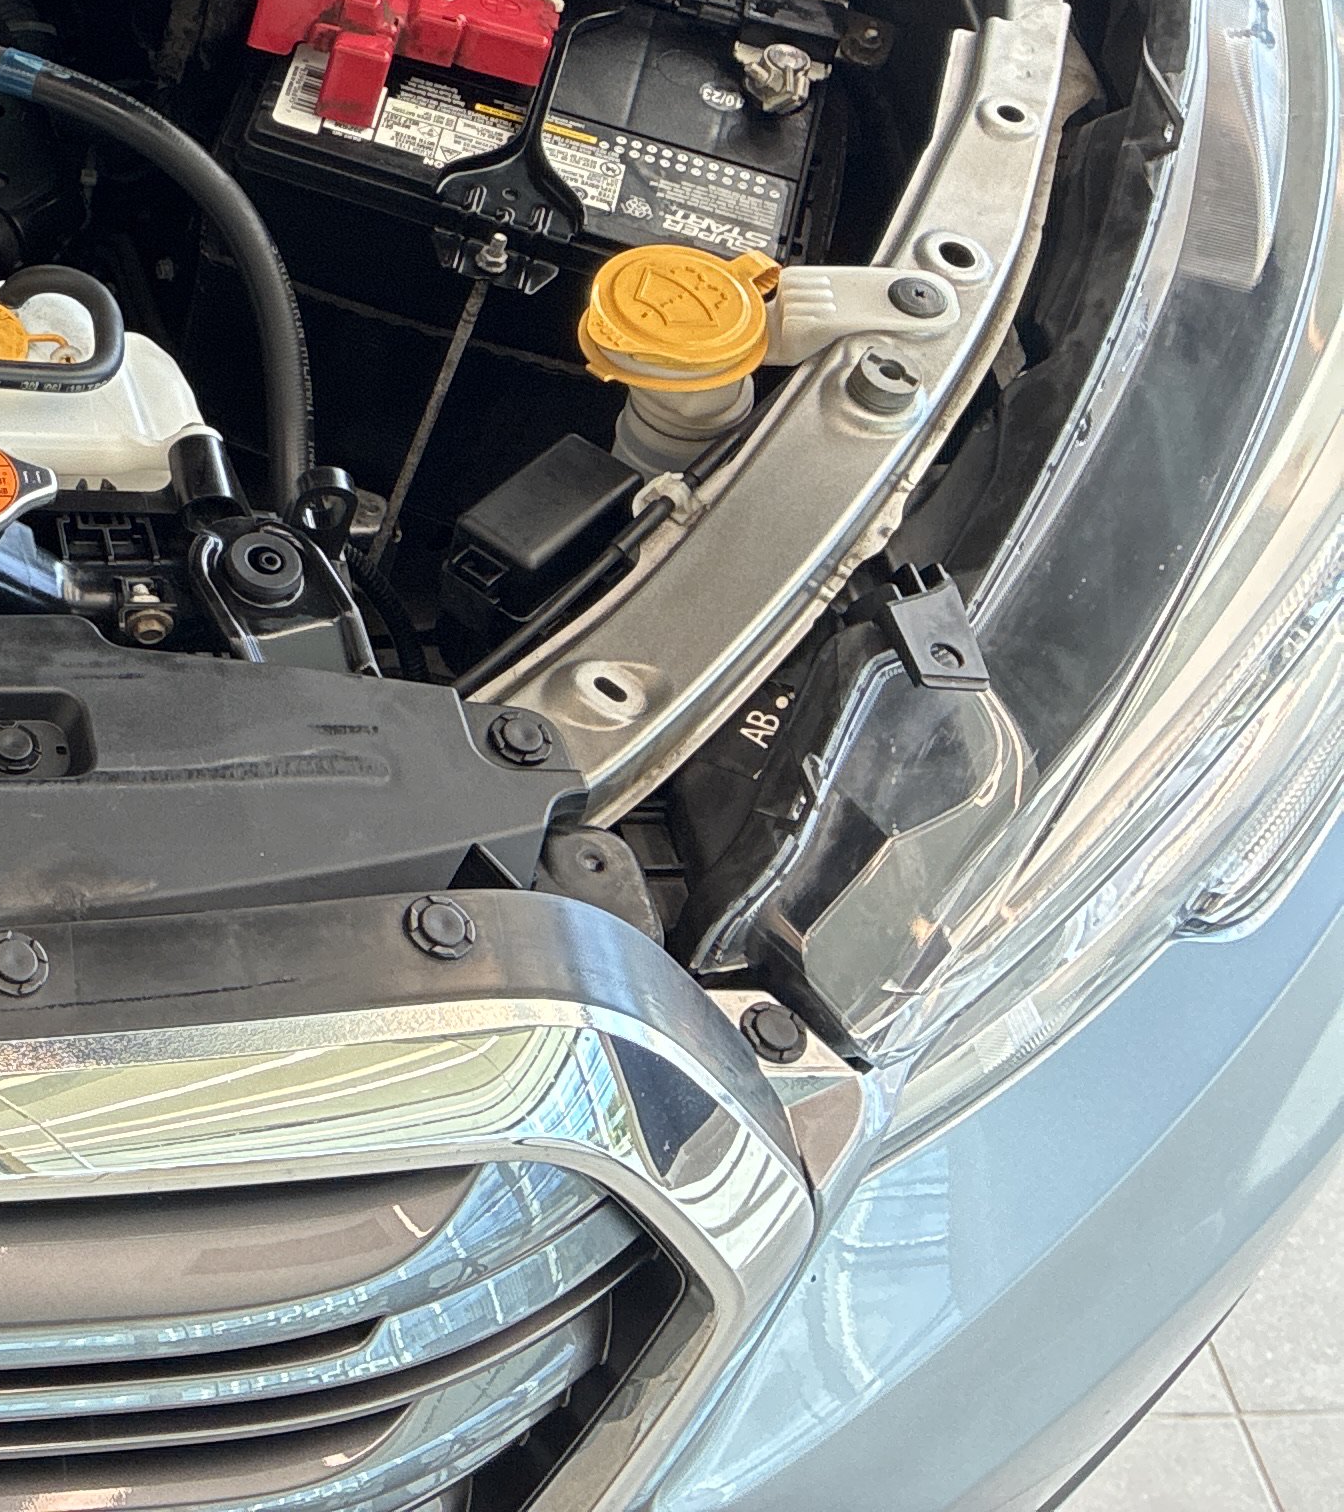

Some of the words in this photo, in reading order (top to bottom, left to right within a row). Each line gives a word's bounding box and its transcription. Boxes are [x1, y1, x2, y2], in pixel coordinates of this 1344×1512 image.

[702, 88, 743, 109] 10/23
[662, 217, 756, 254] SUPER
[664, 208, 772, 249] START
[740, 710, 780, 749] AB
